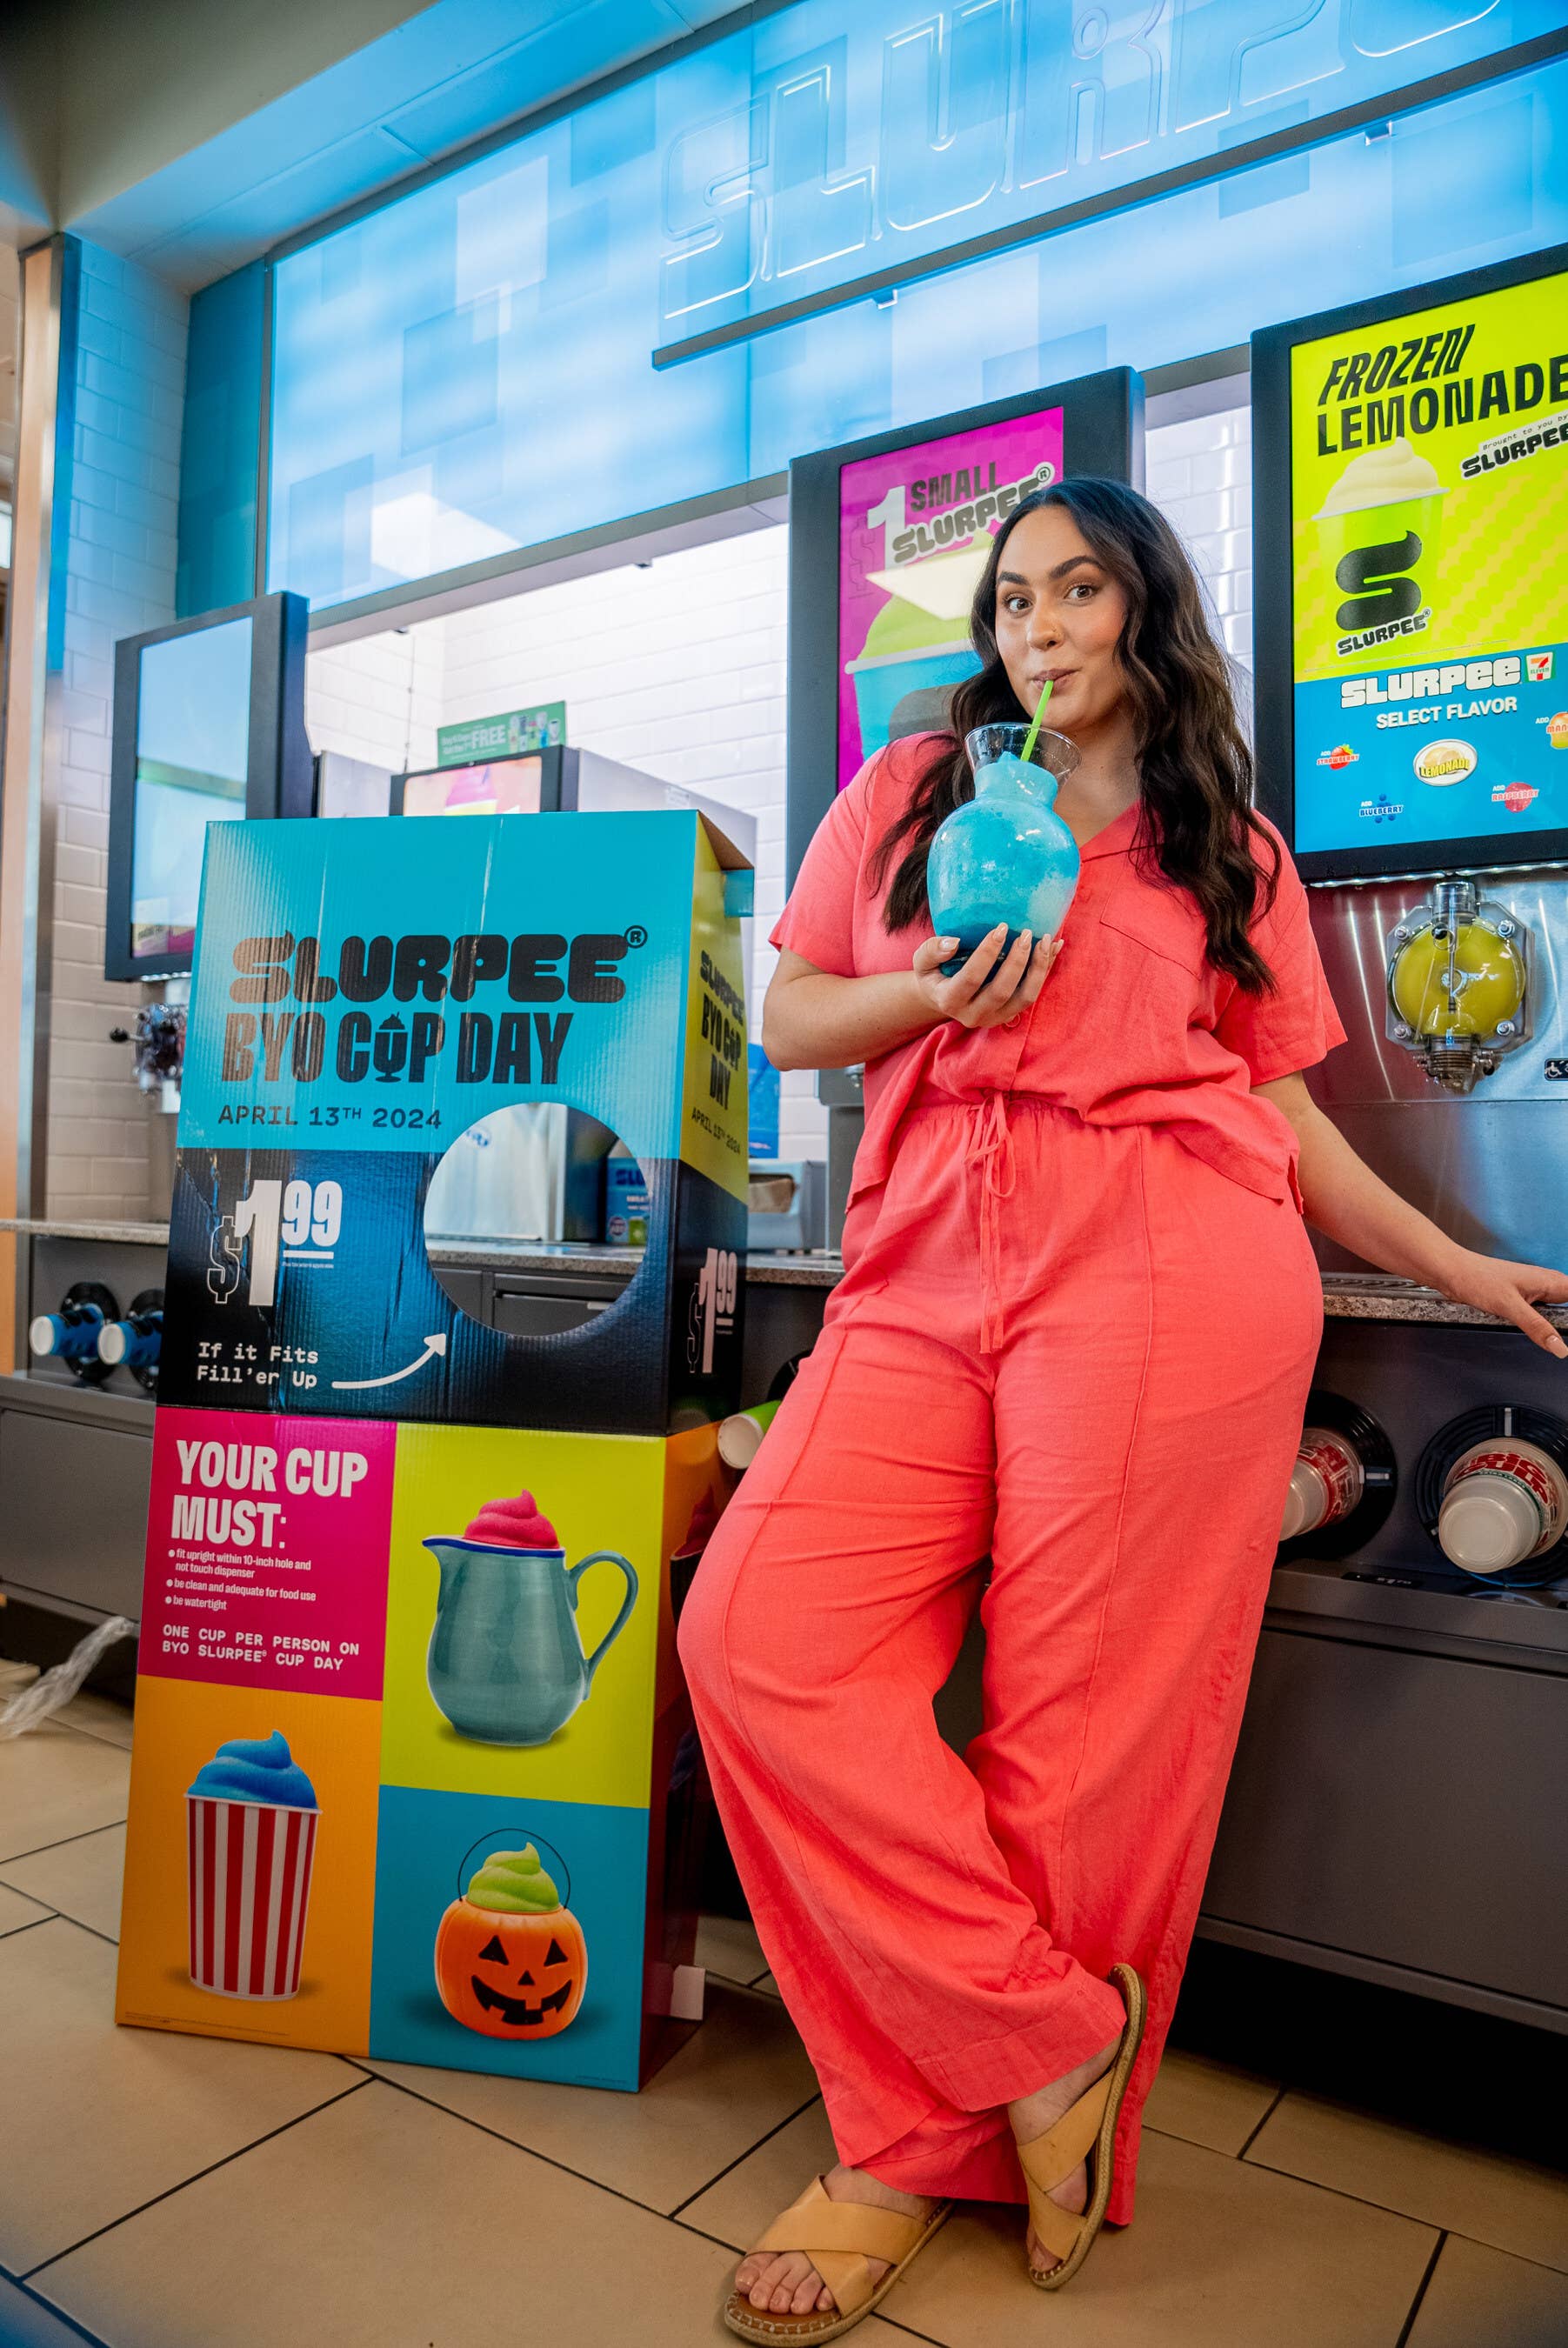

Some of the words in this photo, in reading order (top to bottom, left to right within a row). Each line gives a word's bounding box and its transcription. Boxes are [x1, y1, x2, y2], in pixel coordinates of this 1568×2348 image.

[1318, 324, 1476, 406] FROZEN
[1318, 355, 1568, 457] LEMONADE
[911, 462, 1002, 512] SMALL
[1377, 706, 1442, 730] SELECT
[1446, 697, 1518, 720] FLAVOR
[1546, 724, 1568, 734] MAN
[1420, 758, 1470, 779] LEMONADE
[221, 1011, 326, 1083] BYO
[336, 1011, 446, 1083] CUP
[455, 1012, 574, 1084] DAY
[709, 1053, 731, 1111] DAY
[218, 1104, 297, 1126] APRIL
[372, 1107, 442, 1130] 2024
[198, 1342, 221, 1361] If
[233, 1344, 258, 1362] it
[270, 1345, 319, 1364] Fits
[292, 1371, 317, 1390] Up
[176, 1439, 278, 1492] YOUR
[285, 1447, 369, 1498] CUP
[170, 1494, 287, 1549] MUST:
[175, 1562, 189, 1572] not
[190, 1564, 213, 1575] touch
[214, 1564, 255, 1578] dispenser
[177, 1548, 186, 1559] fit
[186, 1551, 216, 1564] upright
[216, 1552, 243, 1564] within
[243, 1555, 275, 1567] 10-inch
[275, 1557, 294, 1569] hole
[295, 1559, 311, 1571] and
[172, 1595, 183, 1605] be
[184, 1597, 227, 1611] watertight
[174, 1578, 184, 1588] be
[185, 1579, 208, 1591] clean
[209, 1582, 224, 1593] and
[225, 1584, 264, 1597] adequate
[265, 1585, 278, 1598] for
[279, 1588, 300, 1600] food
[300, 1591, 317, 1601] use
[162, 1640, 190, 1654] BYO
[275, 1652, 304, 1667] CUP
[313, 1657, 344, 1671] DAY
[163, 1624, 190, 1638] ONE
[198, 1628, 226, 1642] CUP
[235, 1631, 264, 1646] PER
[272, 1635, 330, 1653] PERSON
[339, 1641, 359, 1656] ON
